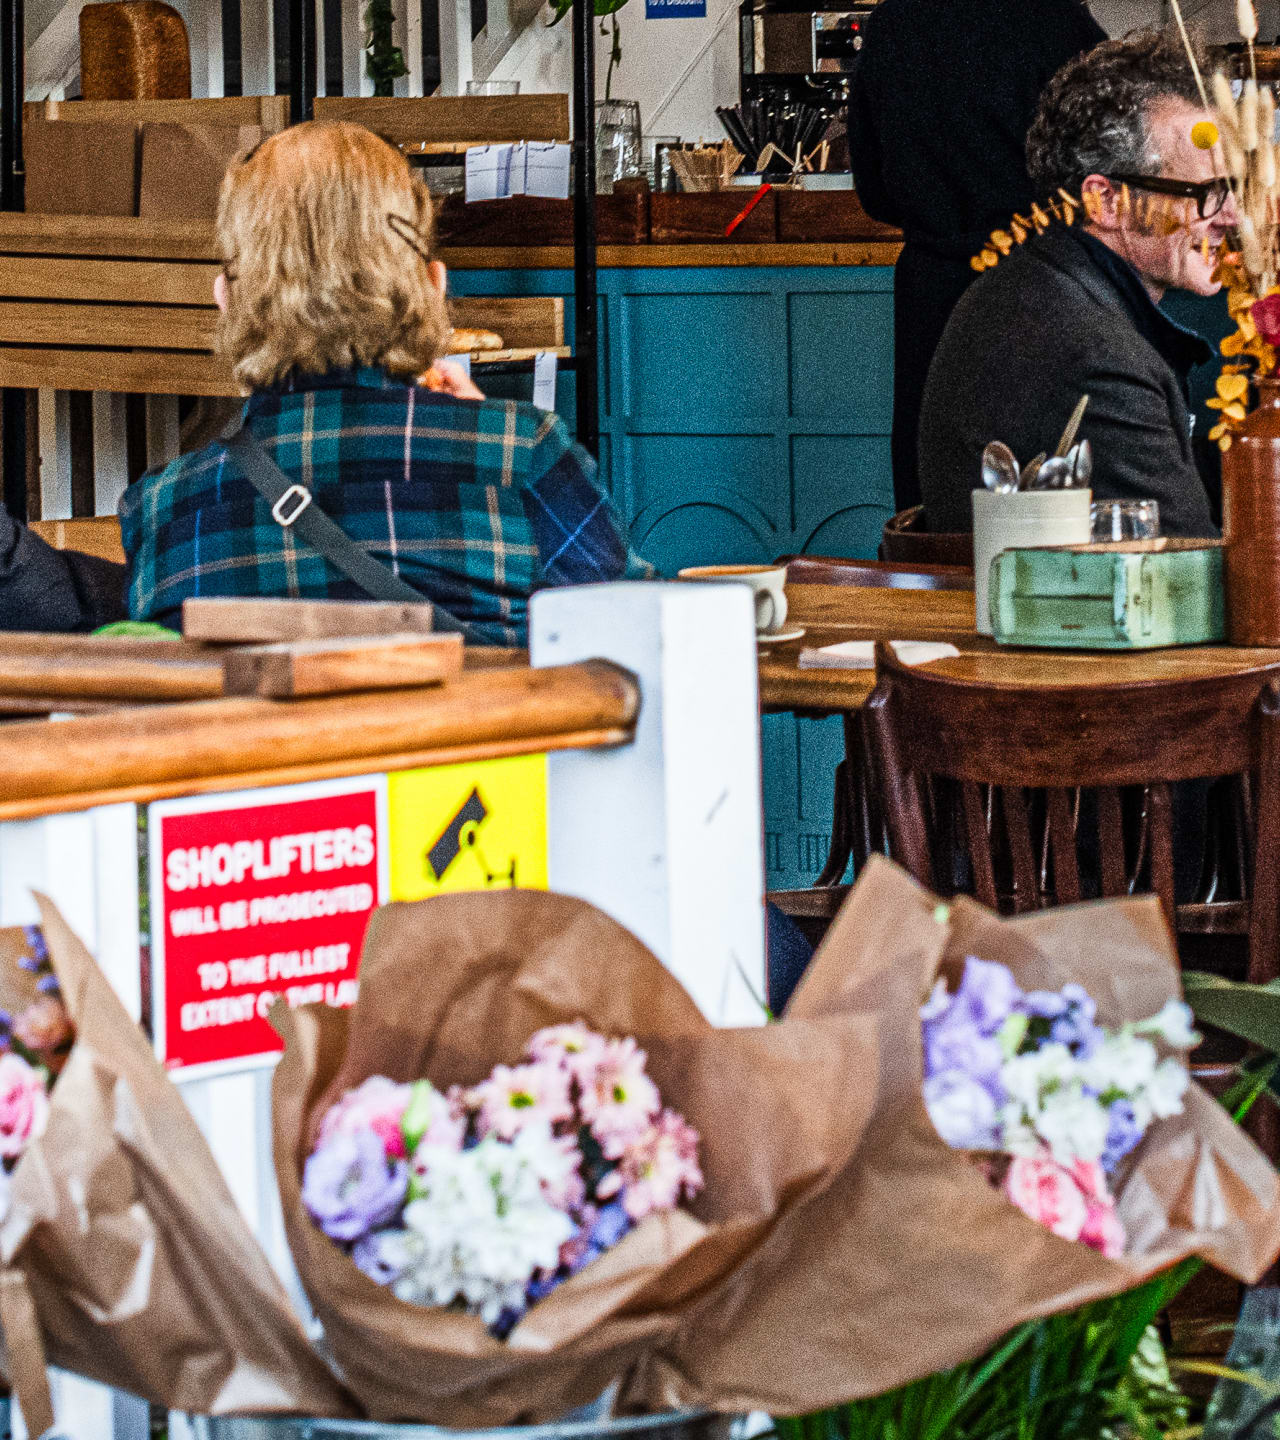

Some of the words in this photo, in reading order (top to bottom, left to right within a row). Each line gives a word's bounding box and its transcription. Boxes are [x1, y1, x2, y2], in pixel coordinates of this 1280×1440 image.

[166, 824, 375, 892] SHOPLIFTERS
[169, 905, 218, 938] WILL
[221, 898, 249, 930] BE
[250, 883, 374, 926] PROSECUTED
[197, 961, 228, 991] TO
[228, 955, 267, 987] THE
[268, 942, 351, 980] FULLEST
[181, 993, 256, 1031] EXTENT
